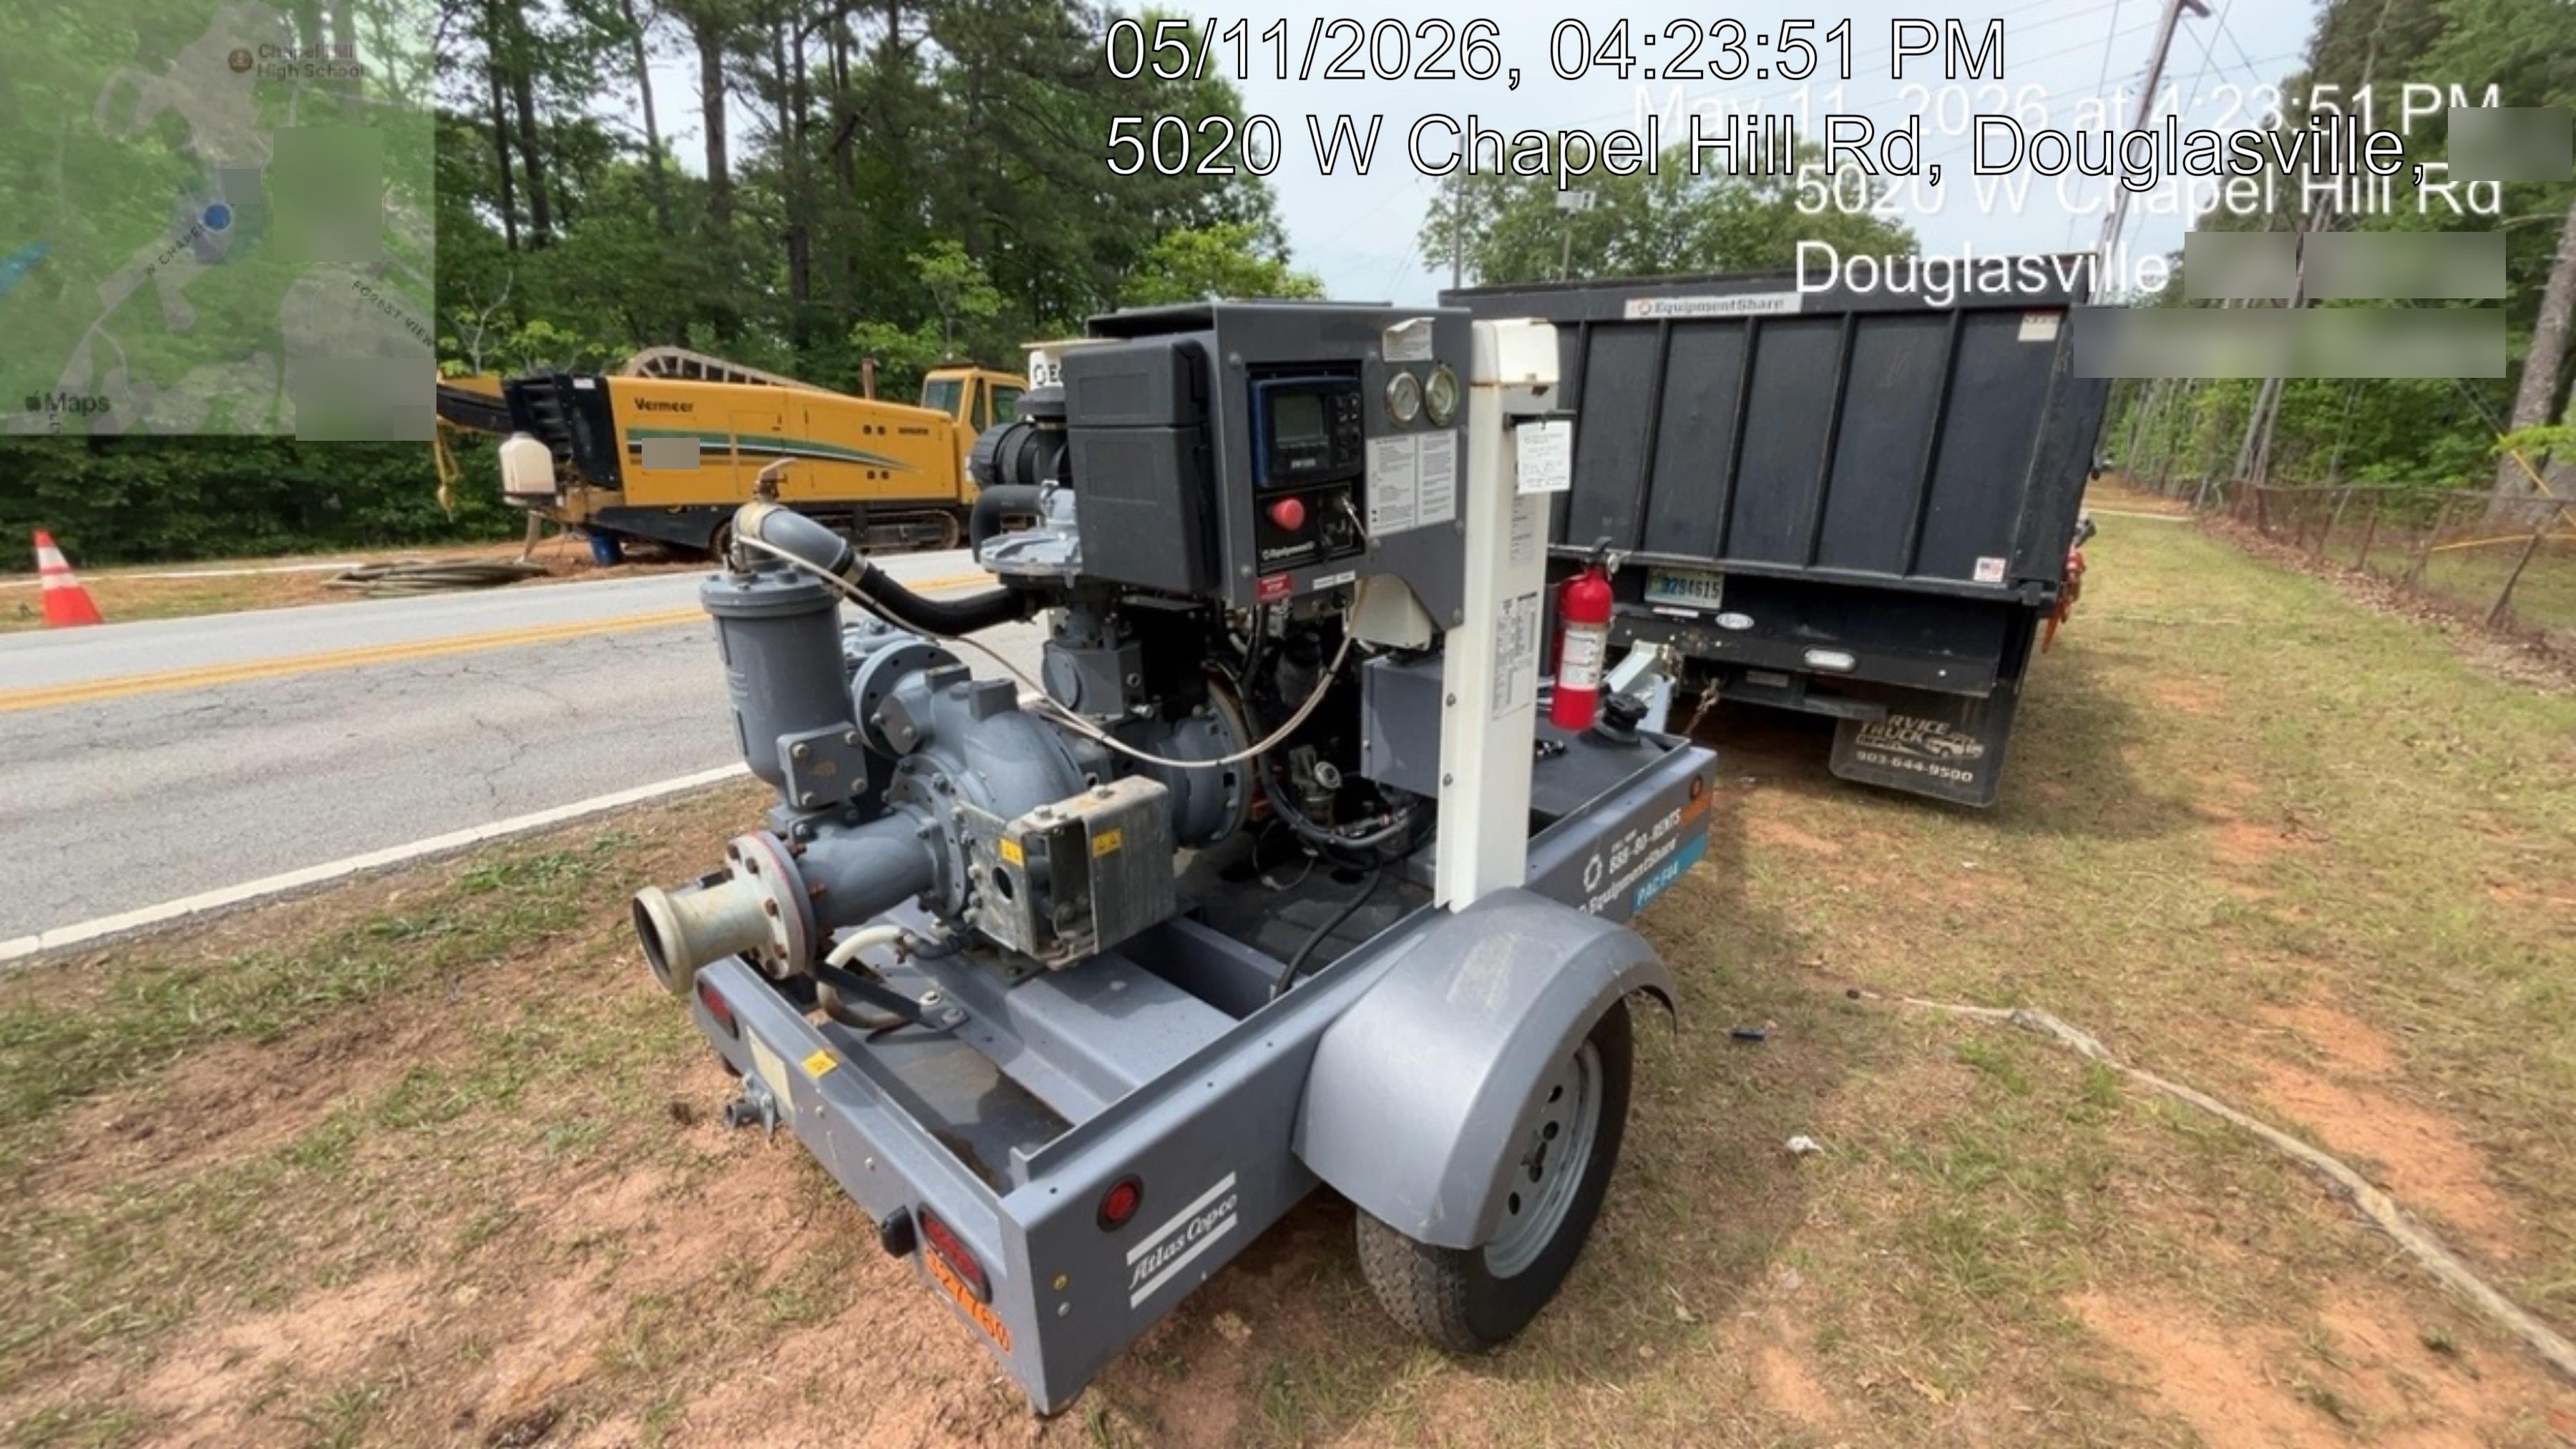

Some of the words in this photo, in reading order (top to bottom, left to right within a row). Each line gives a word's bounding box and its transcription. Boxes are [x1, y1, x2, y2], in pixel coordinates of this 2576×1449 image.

[1654, 297, 1785, 315] EquipmentShare
[633, 396, 694, 413] Vermeer
[1888, 714, 1951, 736] RVICE
[1128, 1233, 1186, 1291] Atlas
[1186, 1193, 1238, 1243] Copco
